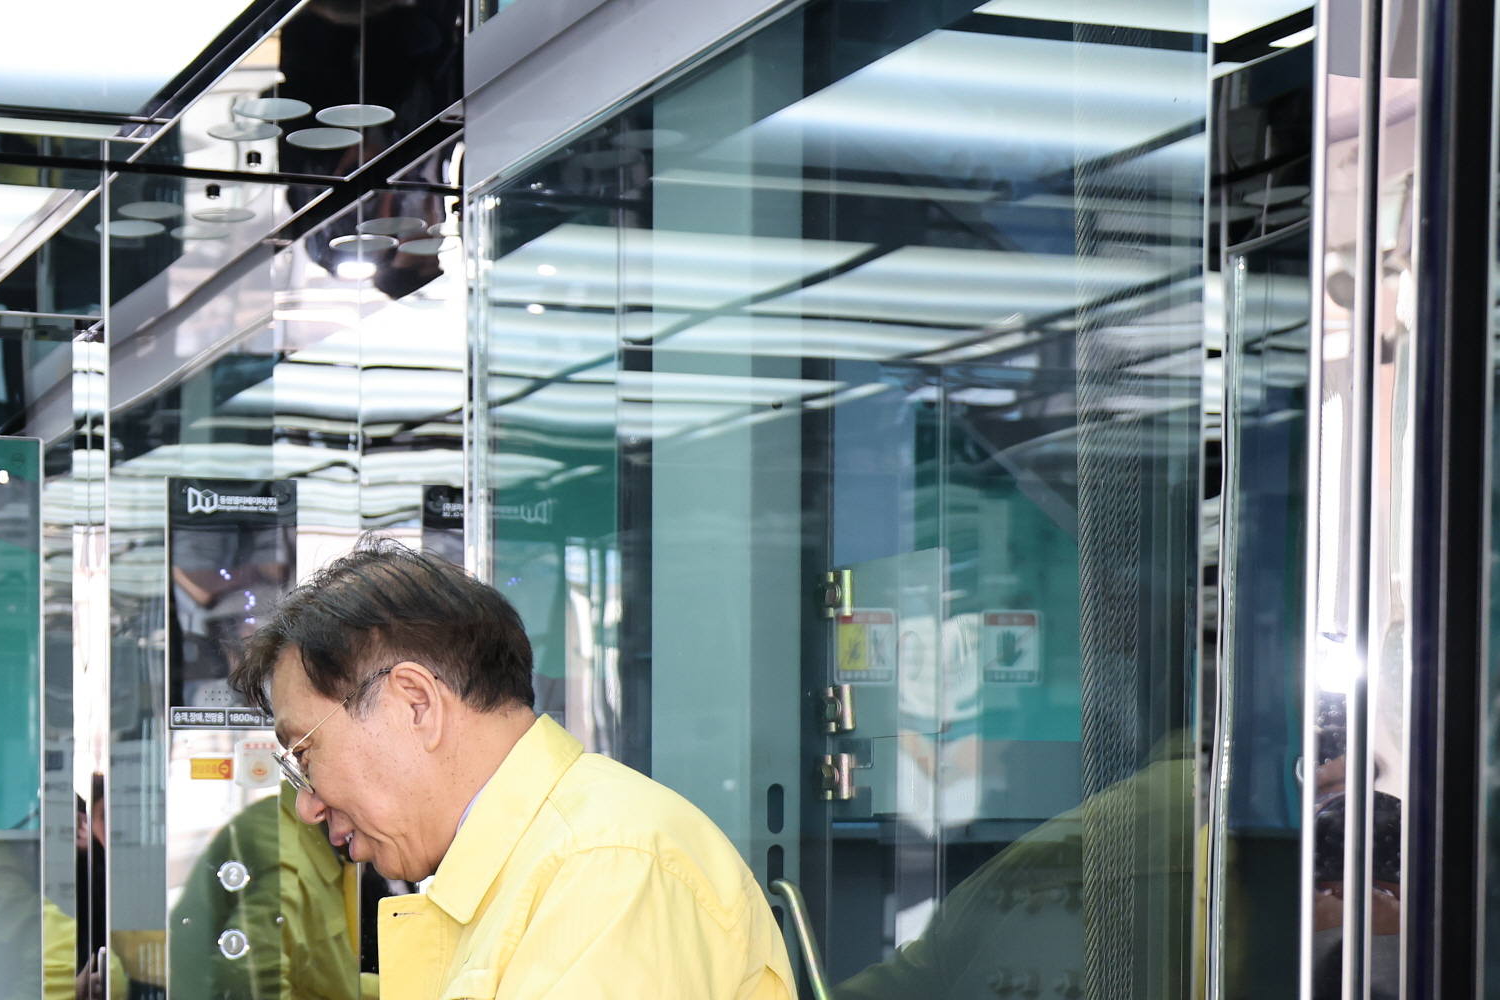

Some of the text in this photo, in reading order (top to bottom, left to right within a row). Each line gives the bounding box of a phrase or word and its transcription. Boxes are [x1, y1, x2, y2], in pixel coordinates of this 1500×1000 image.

[229, 713, 260, 723] 1800kg
[229, 867, 238, 880] 2
[230, 935, 237, 948] 1
